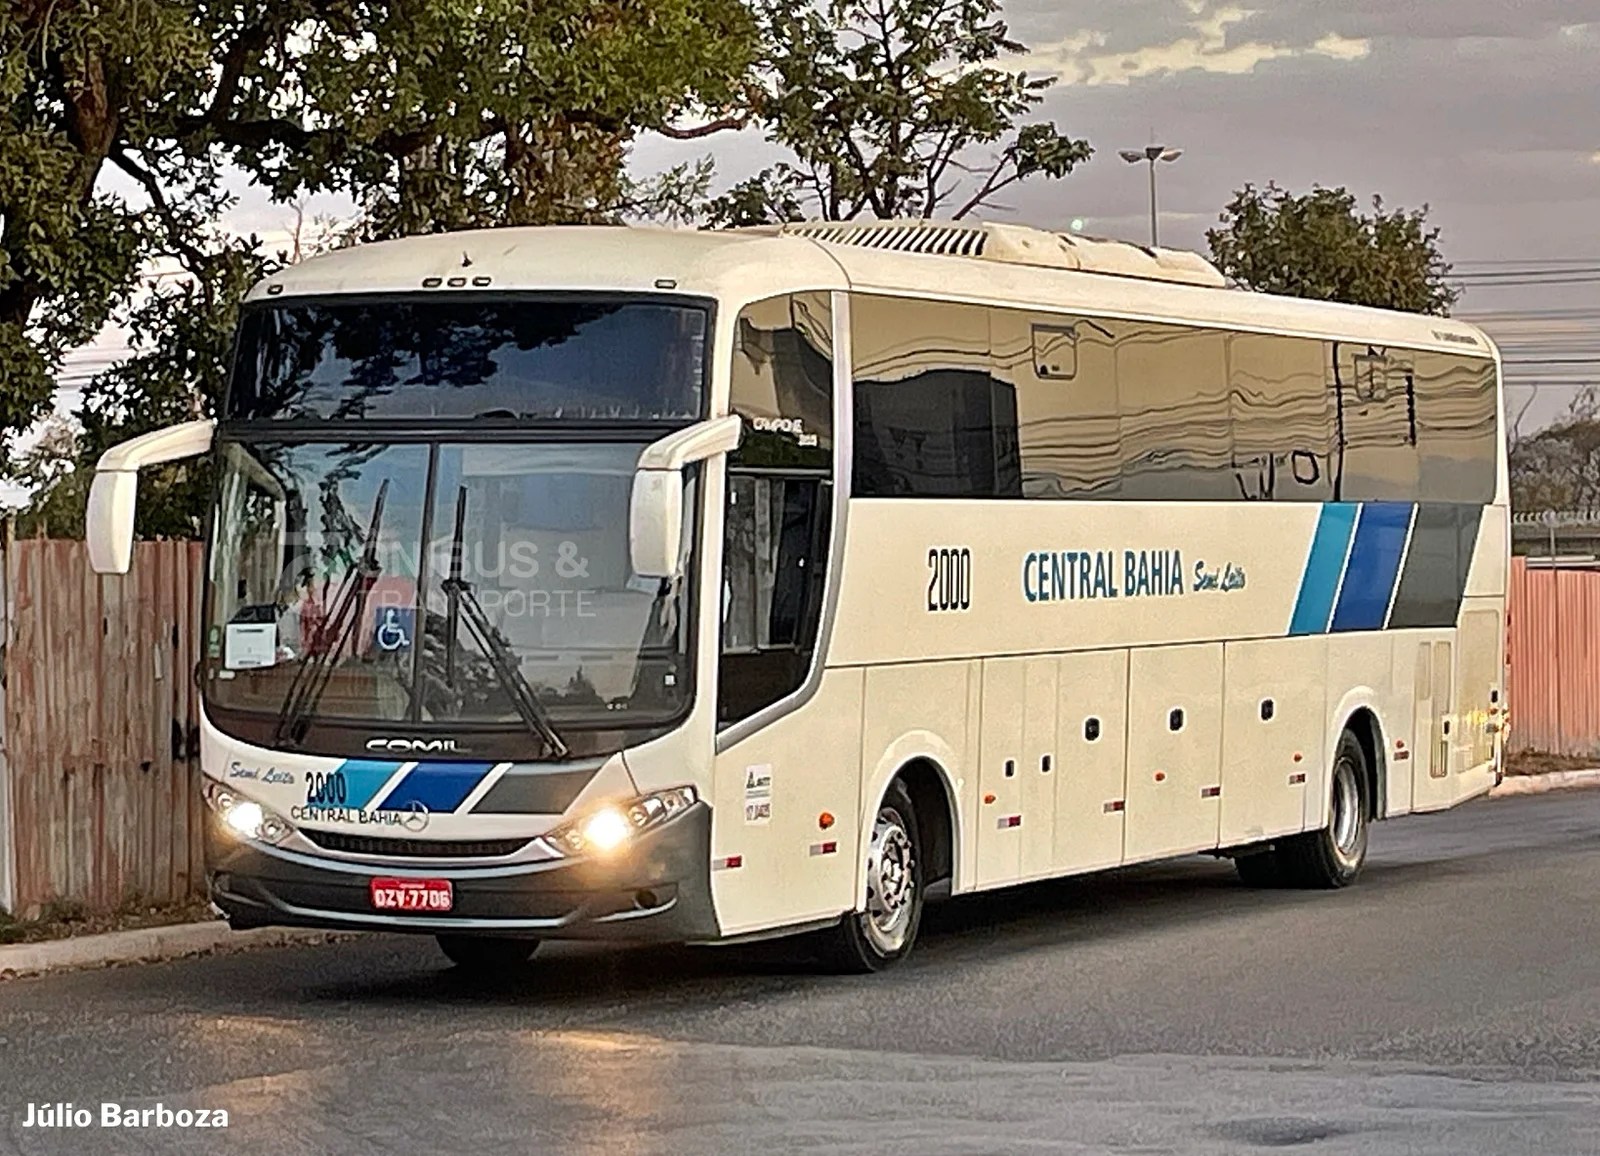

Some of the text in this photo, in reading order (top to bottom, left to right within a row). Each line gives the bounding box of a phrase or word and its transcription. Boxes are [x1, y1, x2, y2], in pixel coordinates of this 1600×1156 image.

[928, 549, 970, 611] 2000
[1024, 552, 1118, 602] CENTRAL
[1125, 550, 1184, 597] BAHIA
[366, 739, 472, 753] COMIL
[305, 771, 347, 804] 2000
[291, 805, 402, 827] CENTRAL BAHIA
